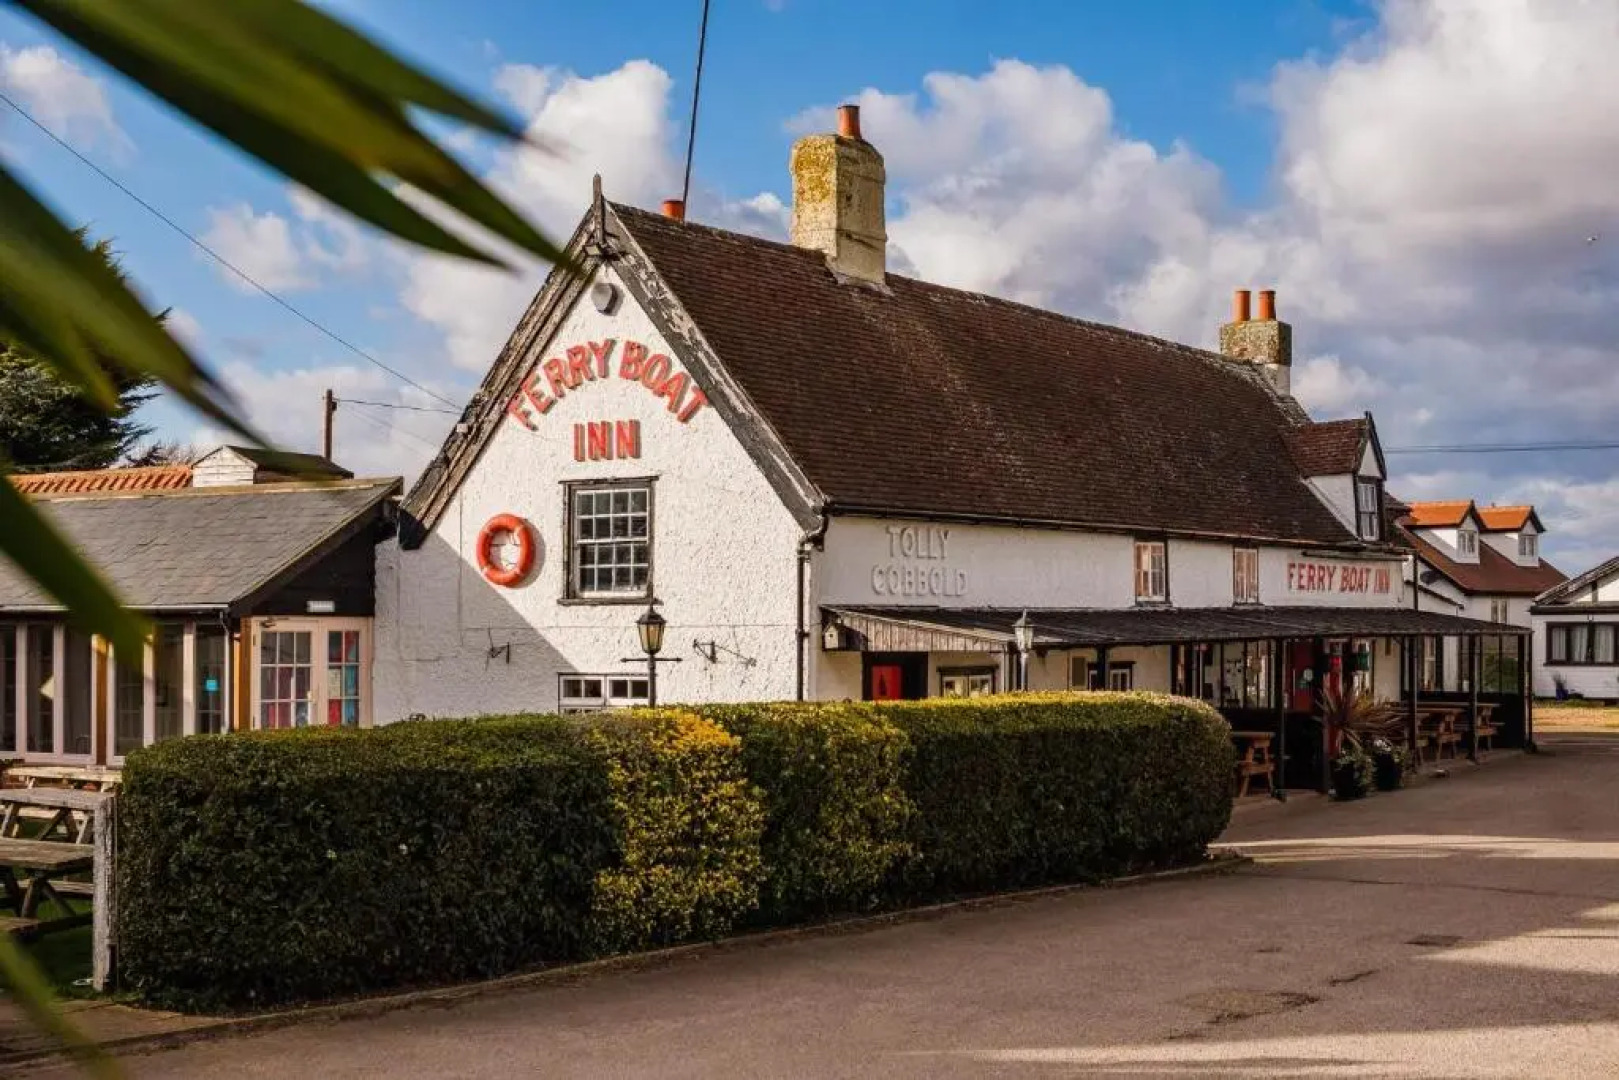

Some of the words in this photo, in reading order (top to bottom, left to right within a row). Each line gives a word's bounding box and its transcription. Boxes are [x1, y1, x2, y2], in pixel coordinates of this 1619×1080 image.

[507, 338, 616, 431] FERRY
[618, 340, 709, 424] BOAT
[573, 419, 641, 462] INN
[886, 525, 949, 560] TOLLY
[871, 563, 967, 597] COBBOLD
[1287, 562, 1336, 592] FERRY
[1340, 565, 1371, 593] BOAT
